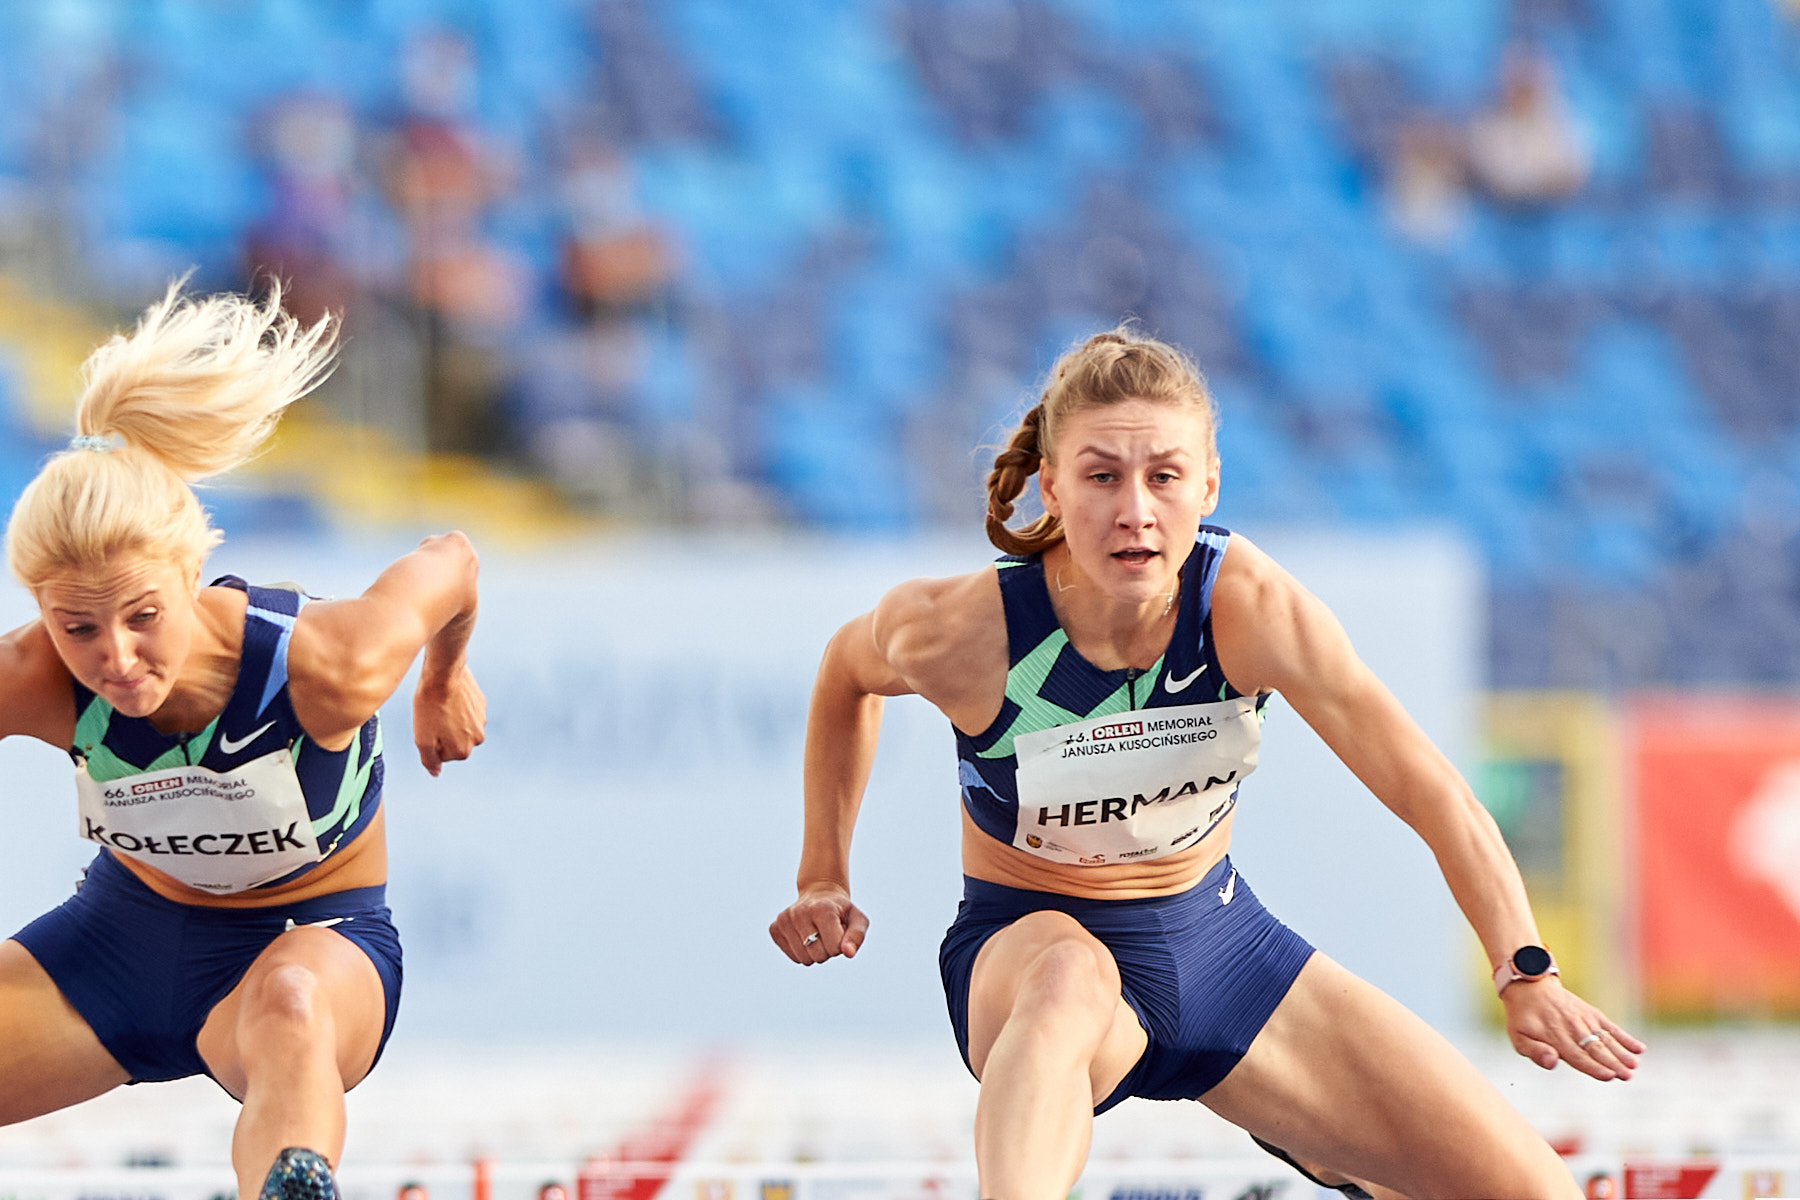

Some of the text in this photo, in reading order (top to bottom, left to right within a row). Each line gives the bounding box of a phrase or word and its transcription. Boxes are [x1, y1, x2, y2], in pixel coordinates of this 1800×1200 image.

[1093, 723, 1141, 739] ORLEN
[1147, 716, 1213, 733] MEMORIAŁ
[1061, 729, 1218, 758] JANUSZA KUSOCIŃSKIEGO
[104, 788, 130, 799] 66.
[133, 778, 182, 795] ORLEN
[1037, 770, 1237, 827] HERMAN
[85, 816, 306, 856] KOŁECZEK
